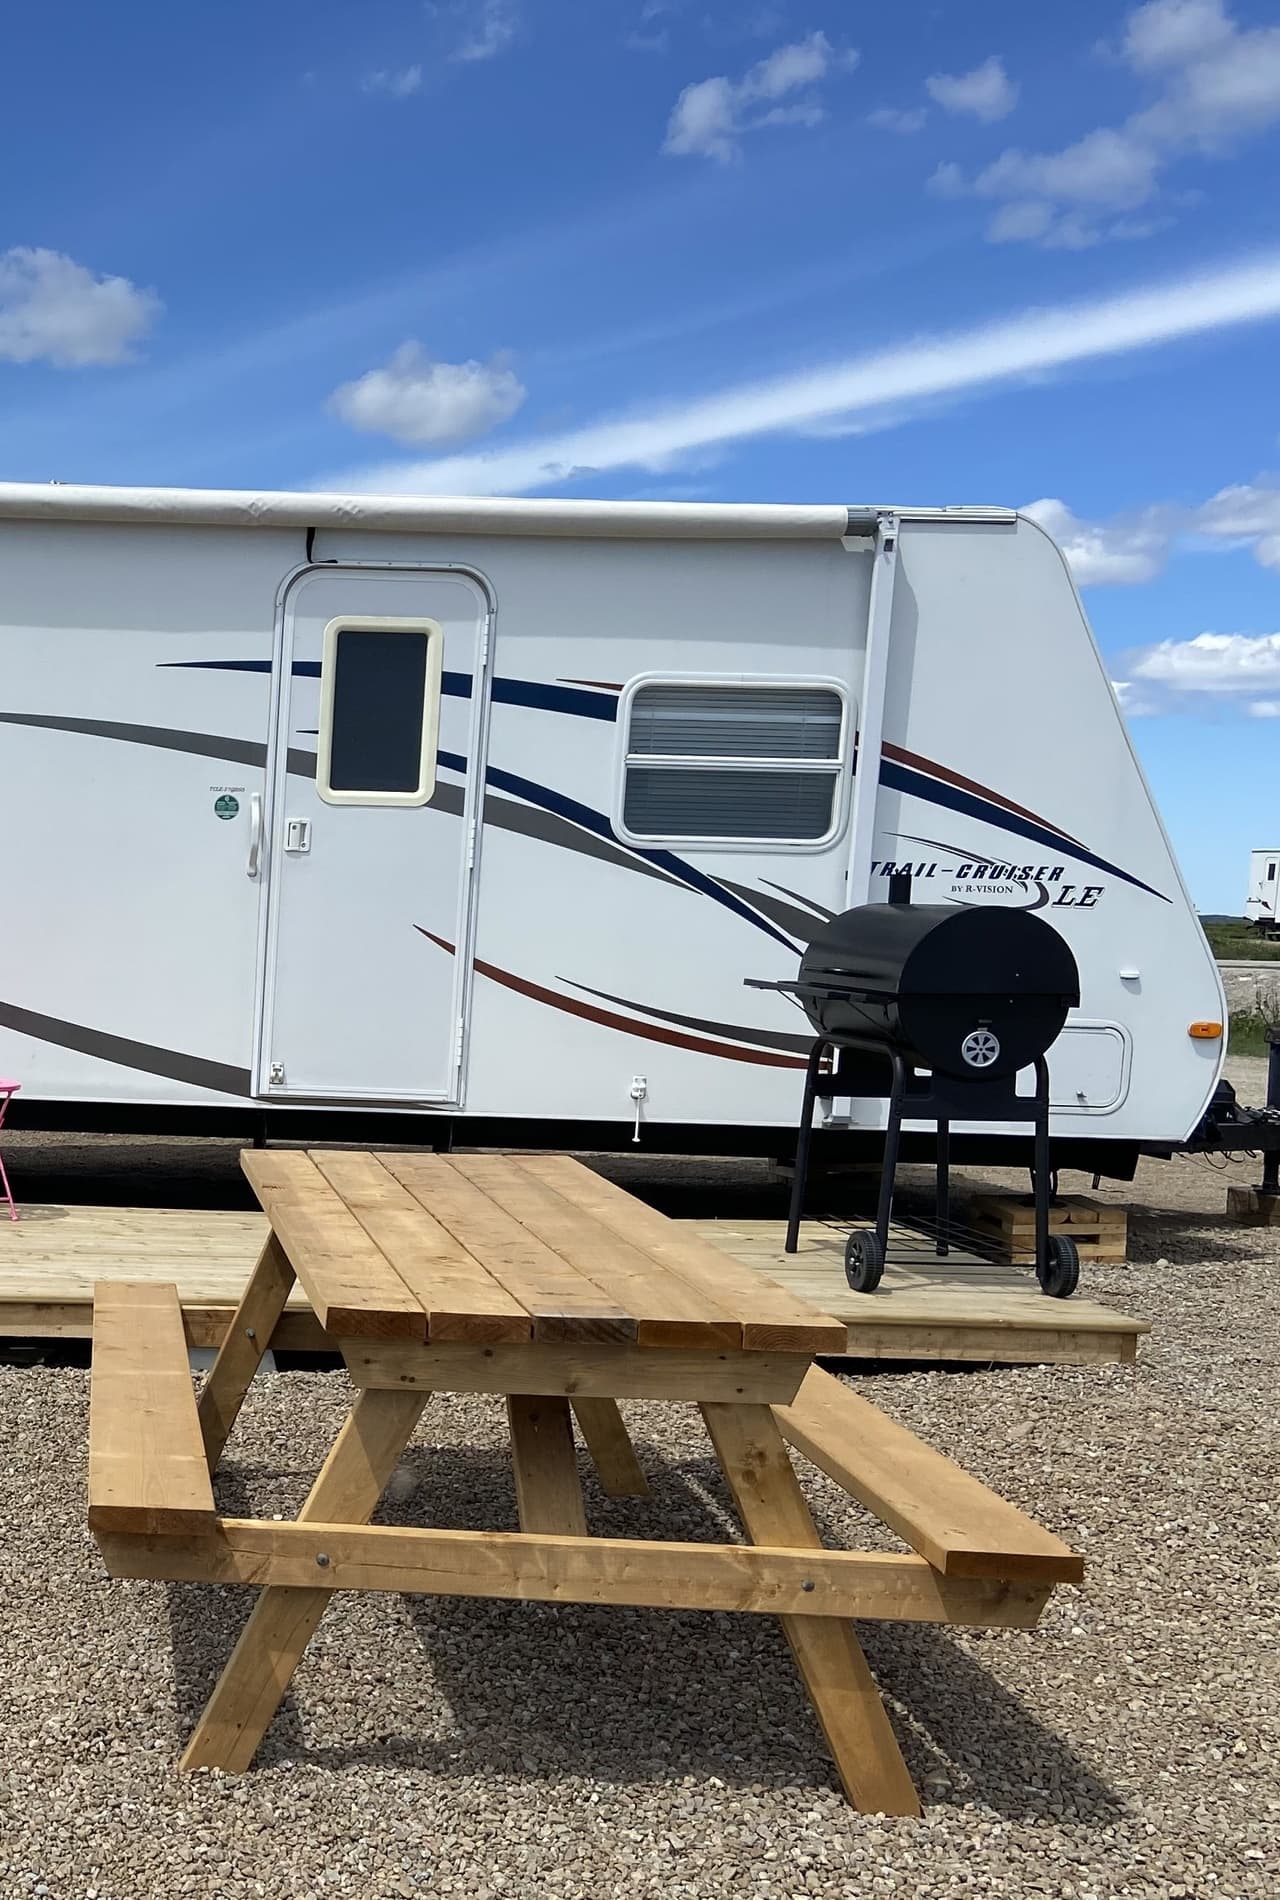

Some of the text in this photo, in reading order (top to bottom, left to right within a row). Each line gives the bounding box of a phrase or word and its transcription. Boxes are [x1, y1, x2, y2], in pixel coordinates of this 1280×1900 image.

[951, 884, 1014, 894] BY R-VISION
[1052, 885, 1105, 907] LE
